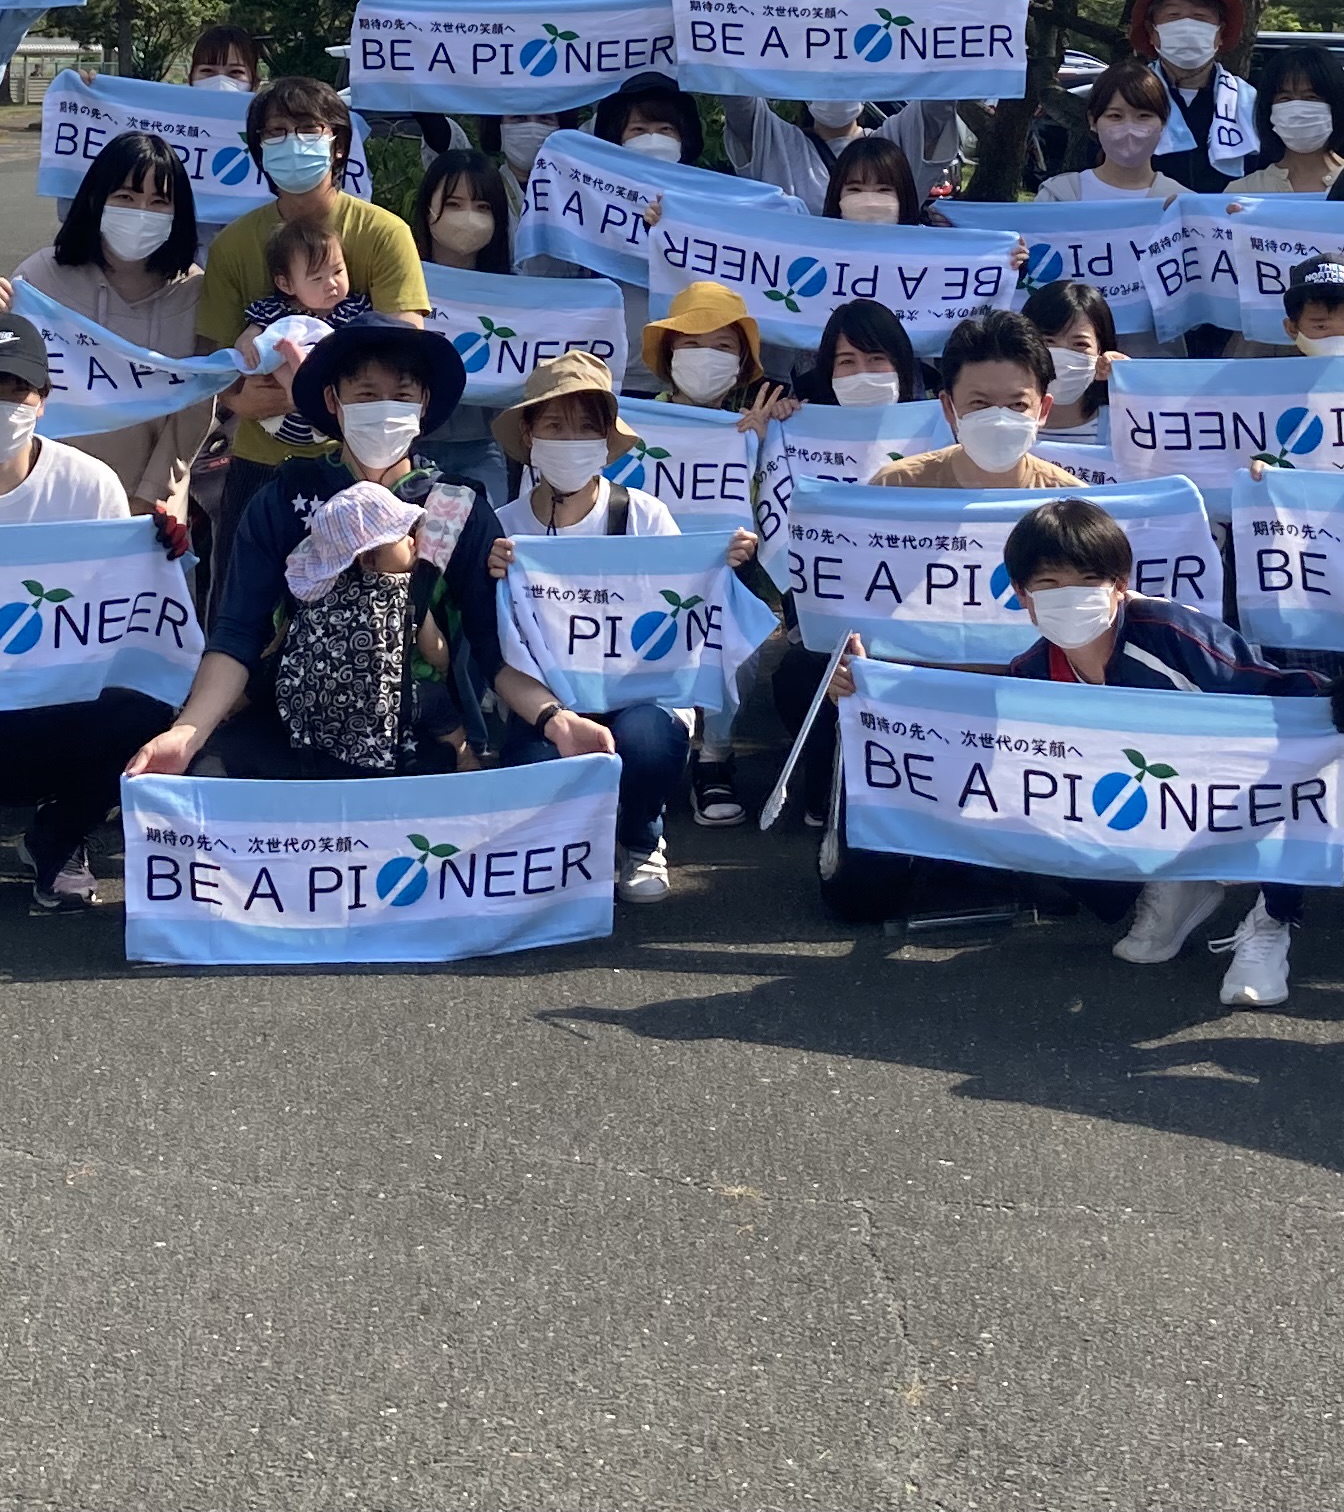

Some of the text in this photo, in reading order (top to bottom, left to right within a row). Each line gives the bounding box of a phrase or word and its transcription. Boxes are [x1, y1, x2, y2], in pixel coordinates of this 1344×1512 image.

[361, 38, 415, 71] BE
[427, 42, 456, 74] A
[690, 20, 746, 56] BE
[759, 25, 789, 59] A
[54, 122, 107, 160] BE
[536, 157, 650, 204] 先へ、次世代の笑顔へ
[562, 190, 584, 226] A
[1147, 226, 1233, 258] 期待の先へ、次世
[897, 265, 929, 300] A
[941, 265, 1002, 301] BE
[1156, 246, 1202, 297] BE
[1210, 249, 1239, 286] A
[87, 355, 118, 390] A
[788, 524, 984, 552] 待の先へ、次世代の笑顔へ
[864, 560, 903, 605] A
[1257, 549, 1331, 596] BE
[568, 604, 723, 661] PIONE
[864, 740, 939, 802] BE
[958, 762, 998, 813] A
[146, 855, 223, 905] BE
[243, 867, 284, 914] A
